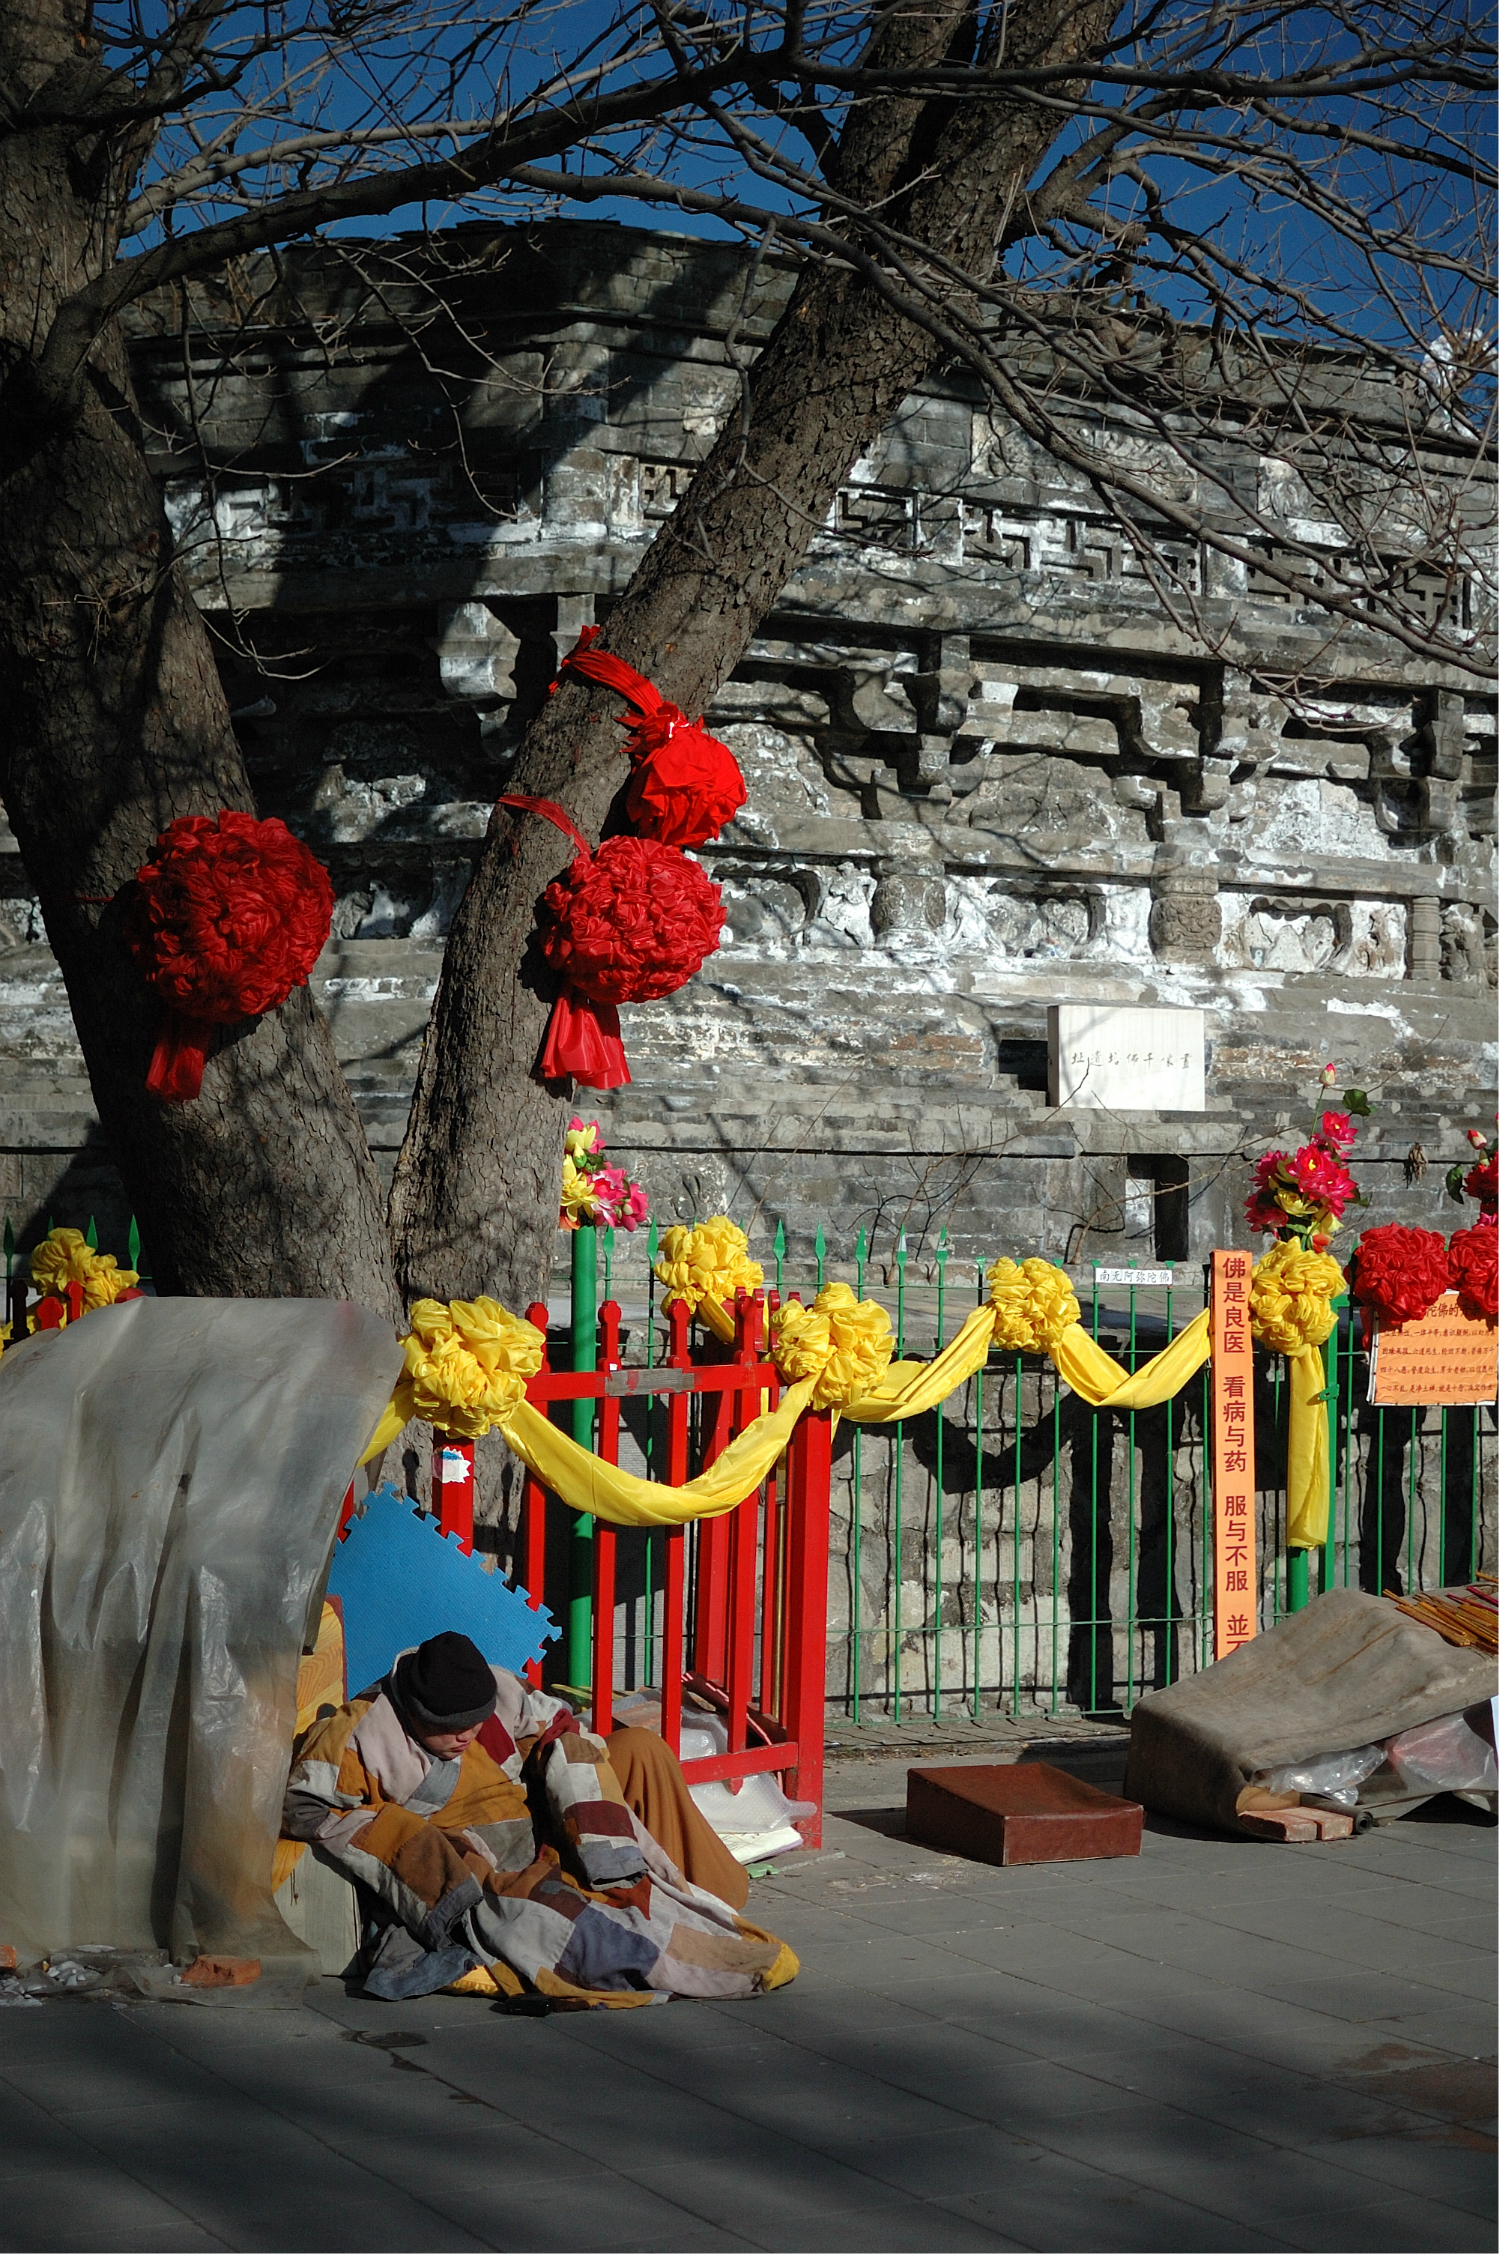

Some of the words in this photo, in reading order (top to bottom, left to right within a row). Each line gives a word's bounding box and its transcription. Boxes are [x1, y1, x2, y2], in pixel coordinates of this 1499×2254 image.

[1099, 1270, 1170, 1283] 南无阿弥陀佛
[1222, 1256, 1246, 1353] 佛是良医
[1222, 1375, 1247, 1472] 看病与药
[1225, 1495, 1248, 1591] 服与不服
